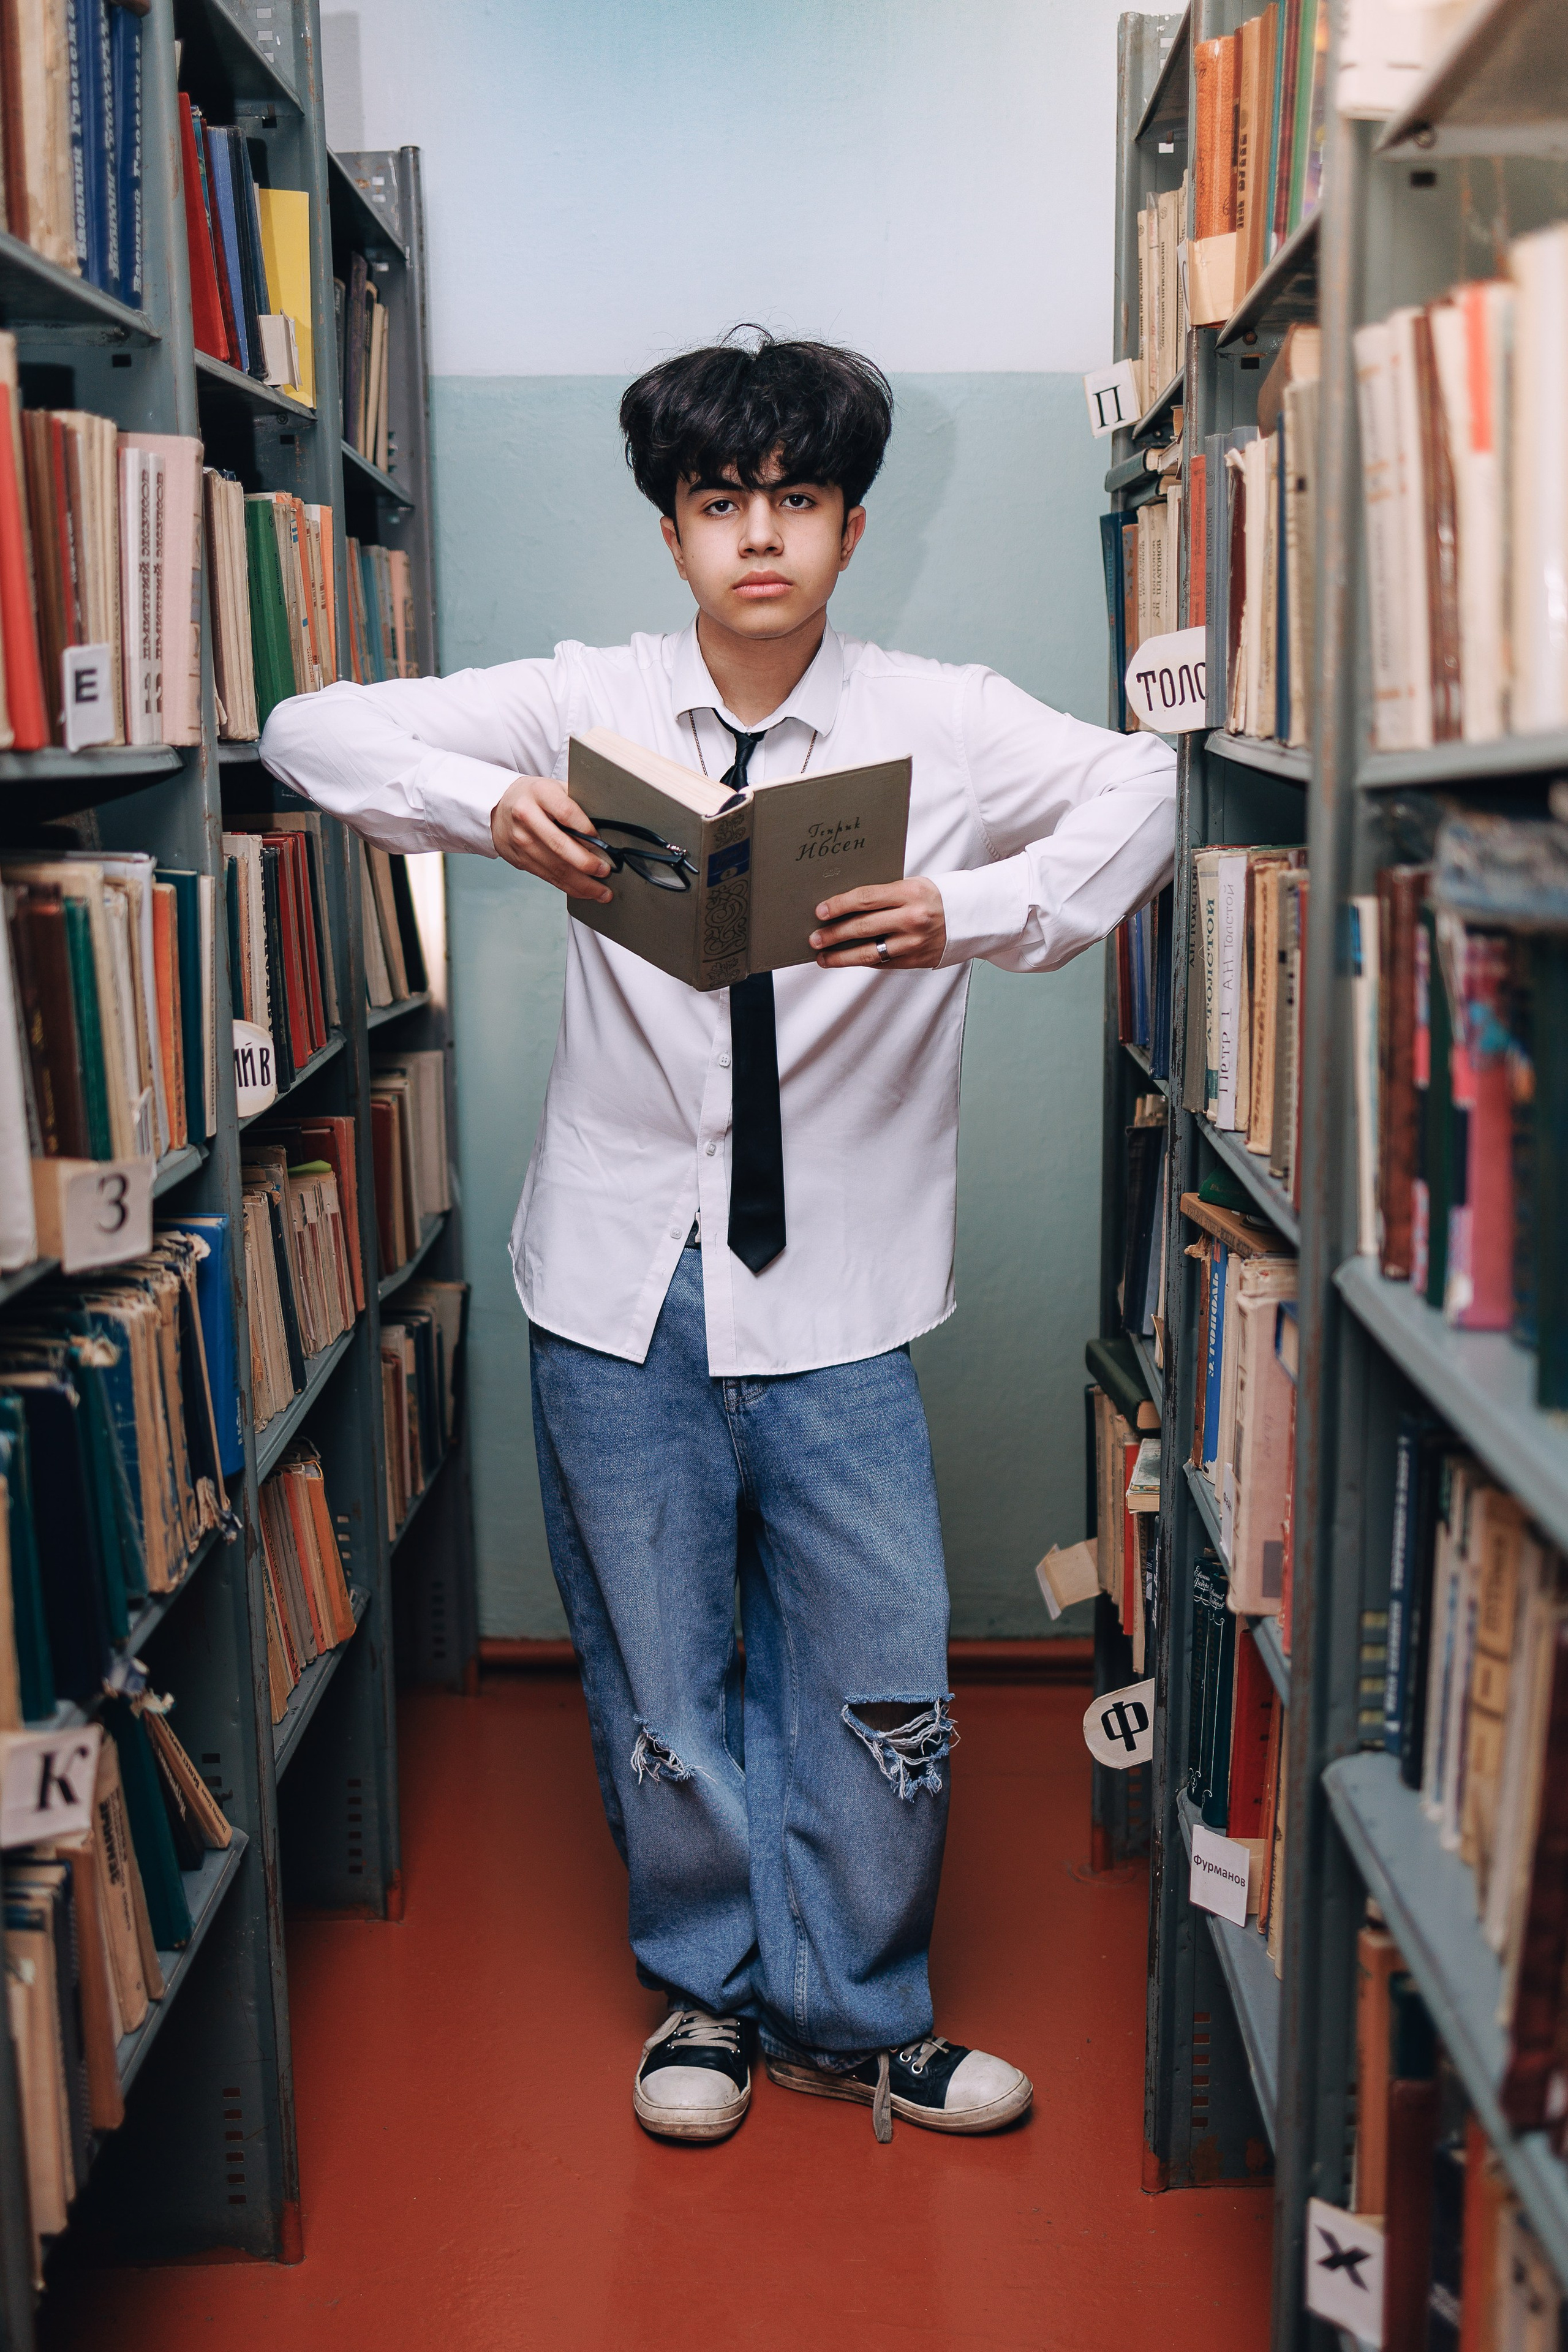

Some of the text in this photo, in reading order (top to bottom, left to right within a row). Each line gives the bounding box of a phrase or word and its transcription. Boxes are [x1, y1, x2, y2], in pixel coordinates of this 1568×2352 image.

[1091, 385, 1125, 429] П
[139, 469, 151, 661] ДМИТРИЙ ЖУКОВ
[154, 471, 164, 661] ДМИТРИЙ ЖУКОВ
[75, 667, 99, 703] Е
[795, 836, 865, 861] Ибсен
[808, 816, 860, 843] Генрик
[1189, 865, 1197, 937] ТОЛСТОЙ
[1209, 1272, 1219, 1357] ТОПОЛЬ
[1100, 1700, 1149, 1752] Ф
[37, 1746, 92, 1812] К
[1192, 1852, 1246, 1888] Фурманов
[1315, 2225, 1371, 2291] Х
